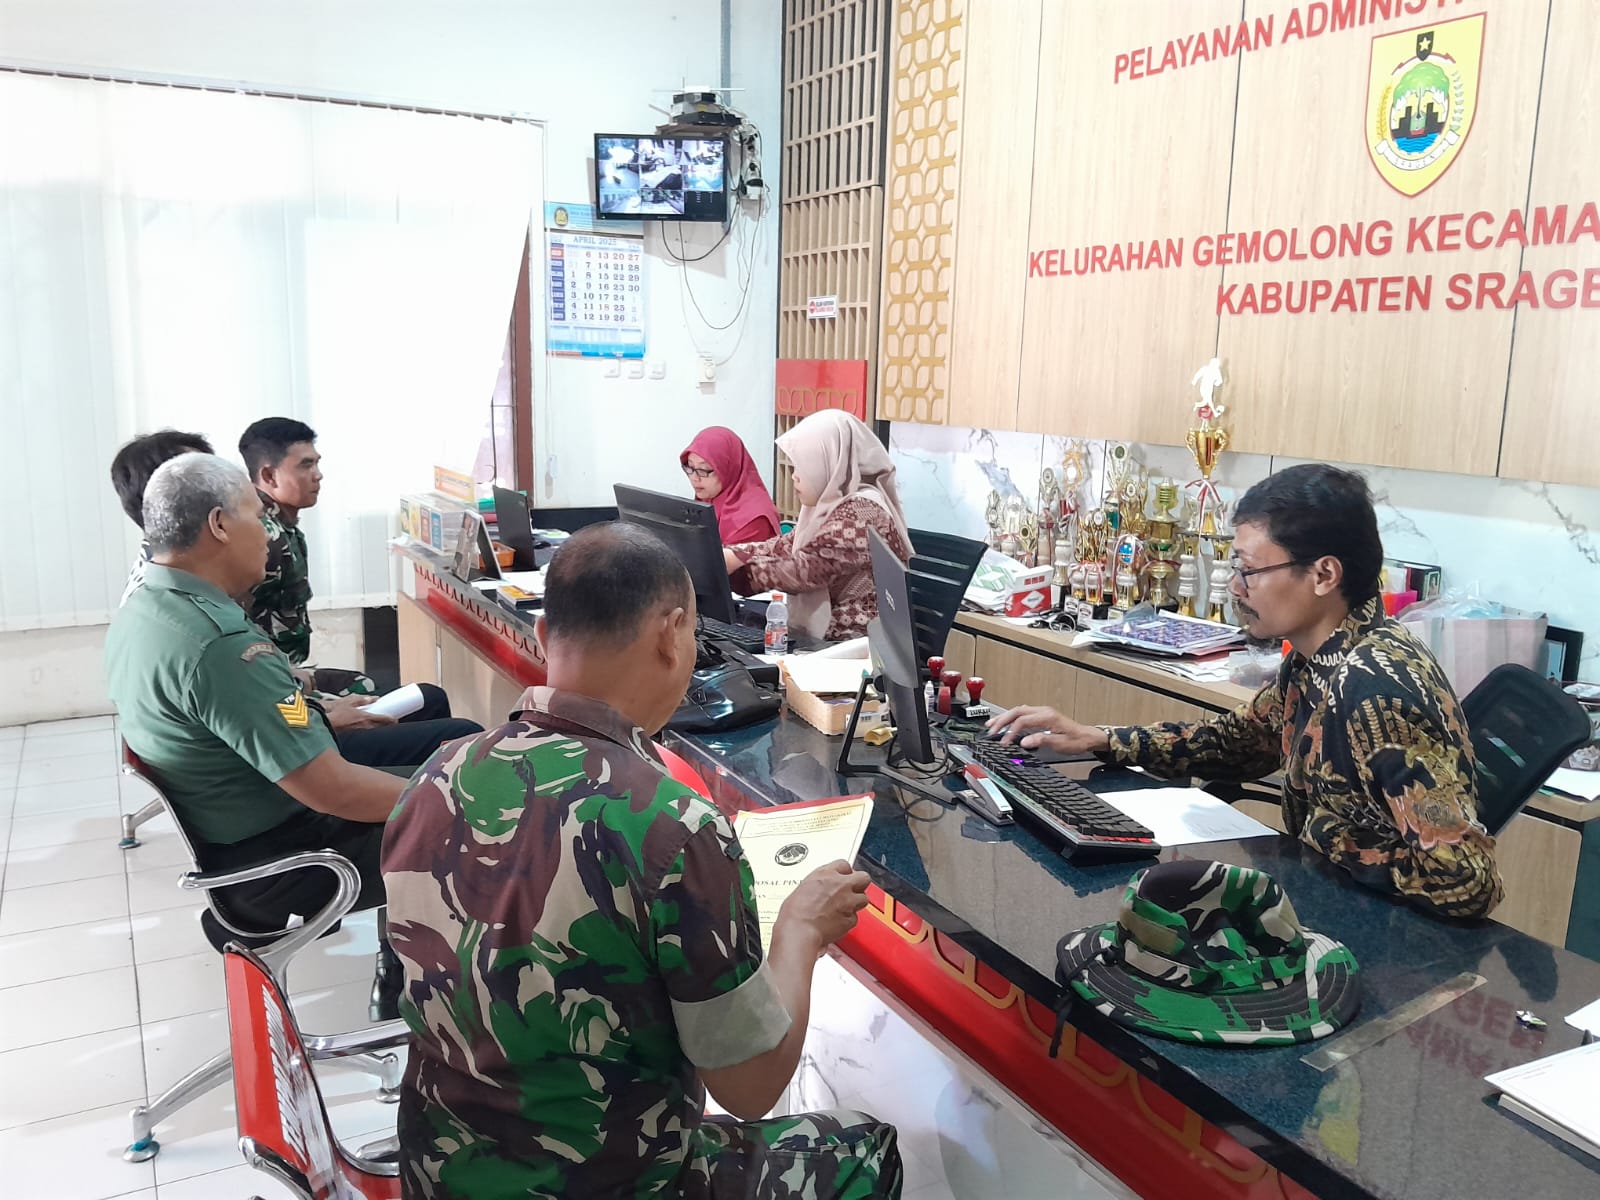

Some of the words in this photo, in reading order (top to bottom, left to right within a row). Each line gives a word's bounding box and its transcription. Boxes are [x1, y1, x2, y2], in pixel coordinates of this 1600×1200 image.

[1113, 27, 1274, 85] PELAYANAN
[1282, 0, 1463, 45] ADMINI
[1028, 237, 1184, 279] KELURAHAN
[1192, 220, 1393, 267] GEMOLONG
[1406, 202, 1600, 254] KECAMA
[1215, 275, 1433, 316] KABUPATEN
[1445, 267, 1600, 311] SRAGE
